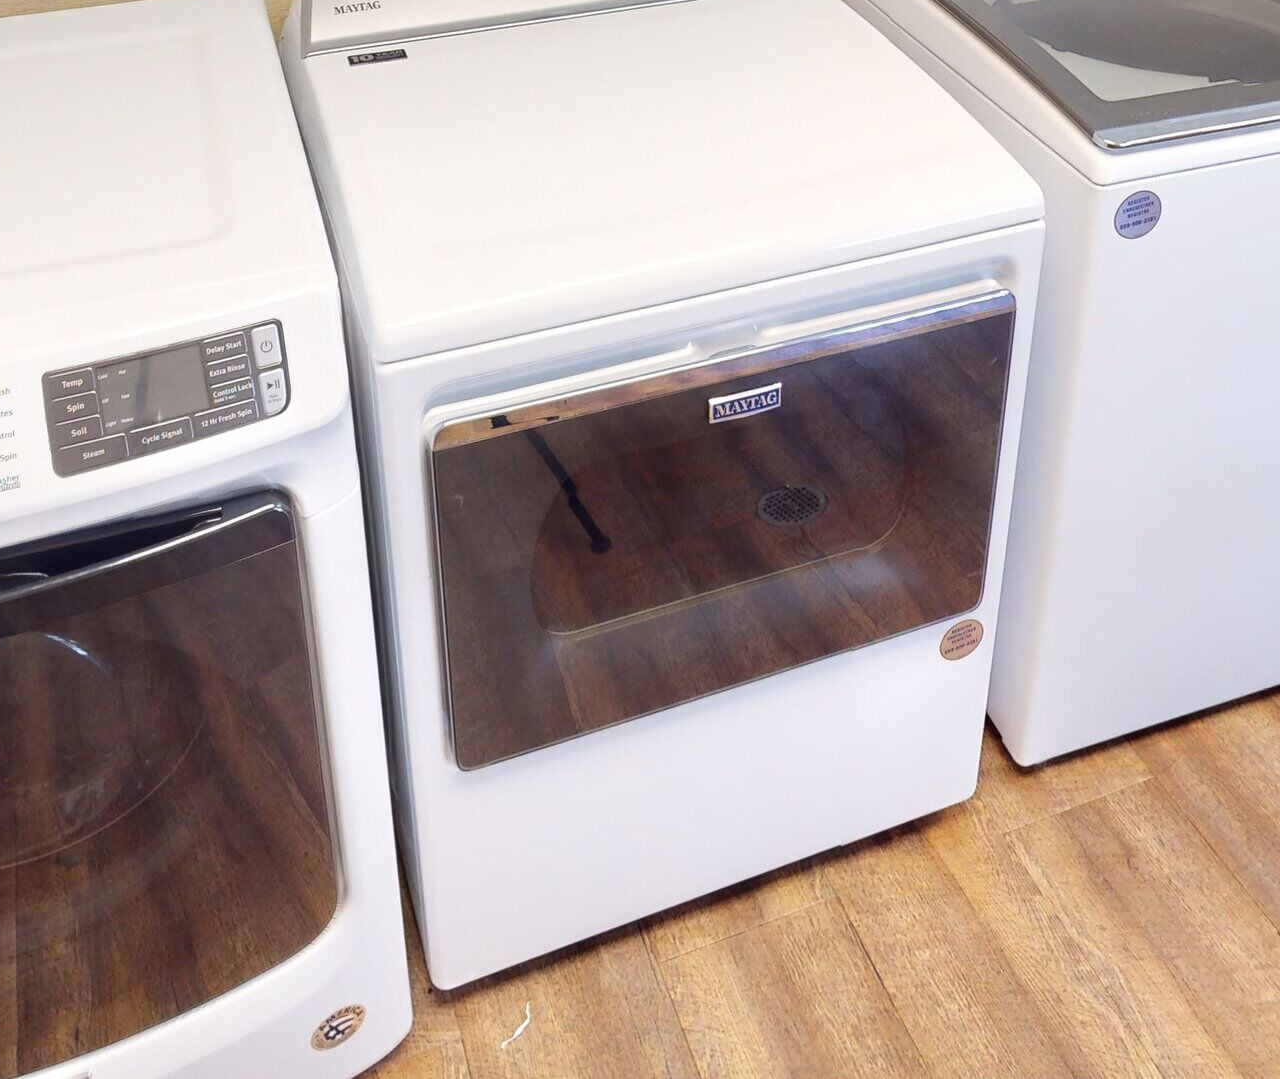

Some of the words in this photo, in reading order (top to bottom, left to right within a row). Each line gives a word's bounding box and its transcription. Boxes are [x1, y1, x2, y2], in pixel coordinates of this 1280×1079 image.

[333, 0, 381, 15] MAYTAG
[350, 54, 374, 63] 10
[206, 345, 225, 355] Delay
[225, 340, 242, 350] Start
[209, 368, 226, 377] Extra
[227, 363, 246, 373] Rinse
[61, 378, 83, 389] Temp
[212, 386, 237, 398] Control
[237, 381, 252, 391] Lock
[66, 402, 85, 413] Spin
[714, 391, 778, 418] MAYTAG
[201, 420, 209, 428] 12
[209, 417, 218, 425] Hr
[218, 413, 237, 423] Fresh
[237, 408, 253, 419] Spin
[70, 426, 88, 437] Soil
[141, 433, 160, 444] Cycle
[160, 428, 183, 441] Signal
[0, 452, 18, 462] Spin
[82, 448, 105, 460] Steam
